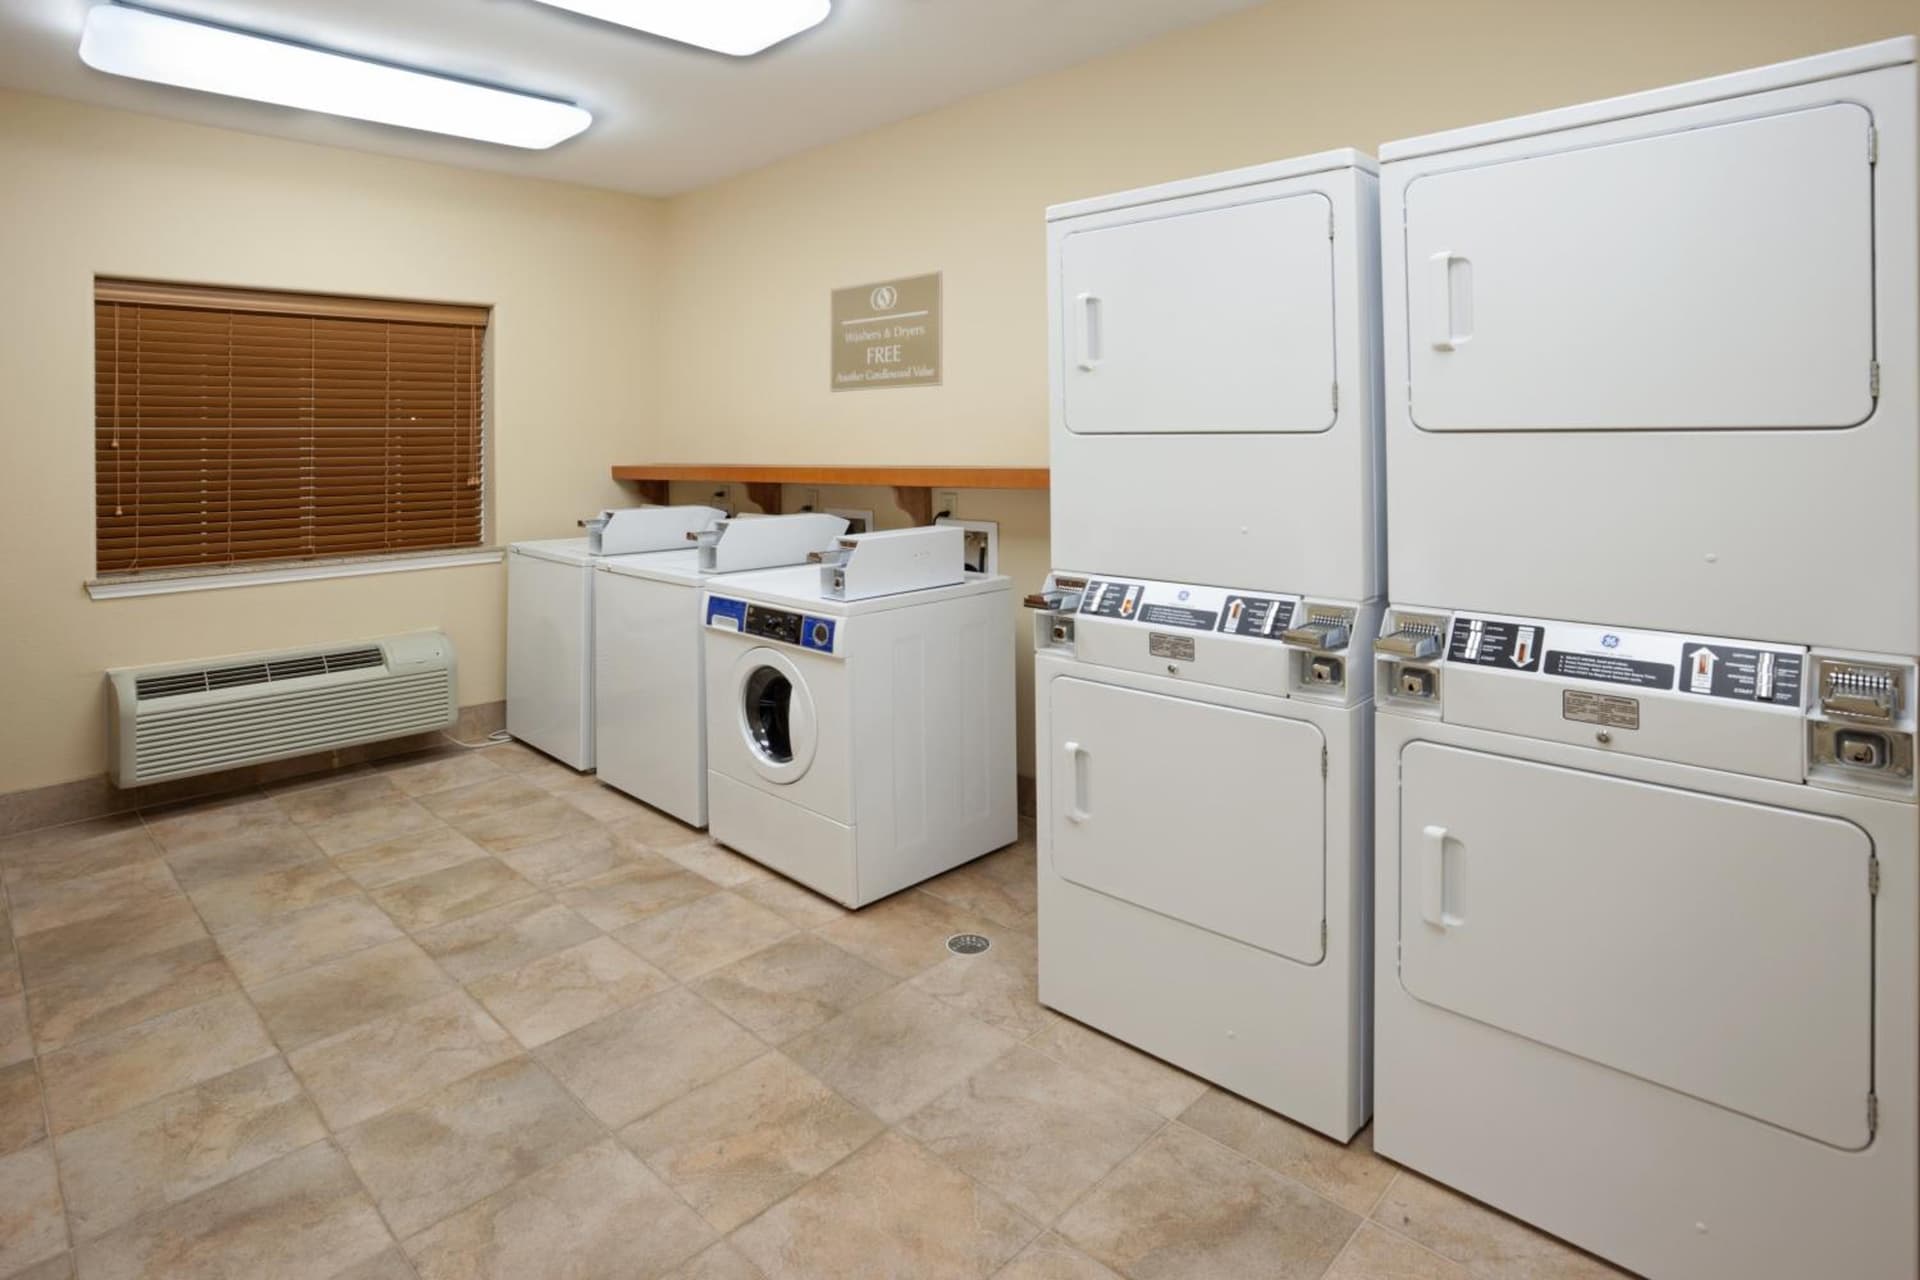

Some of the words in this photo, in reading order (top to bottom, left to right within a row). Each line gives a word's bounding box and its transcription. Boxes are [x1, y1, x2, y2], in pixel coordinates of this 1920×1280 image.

[844, 327, 881, 343] Washers
[884, 328, 892, 339] &
[894, 325, 926, 341] Dryers
[866, 344, 902, 365] FREE
